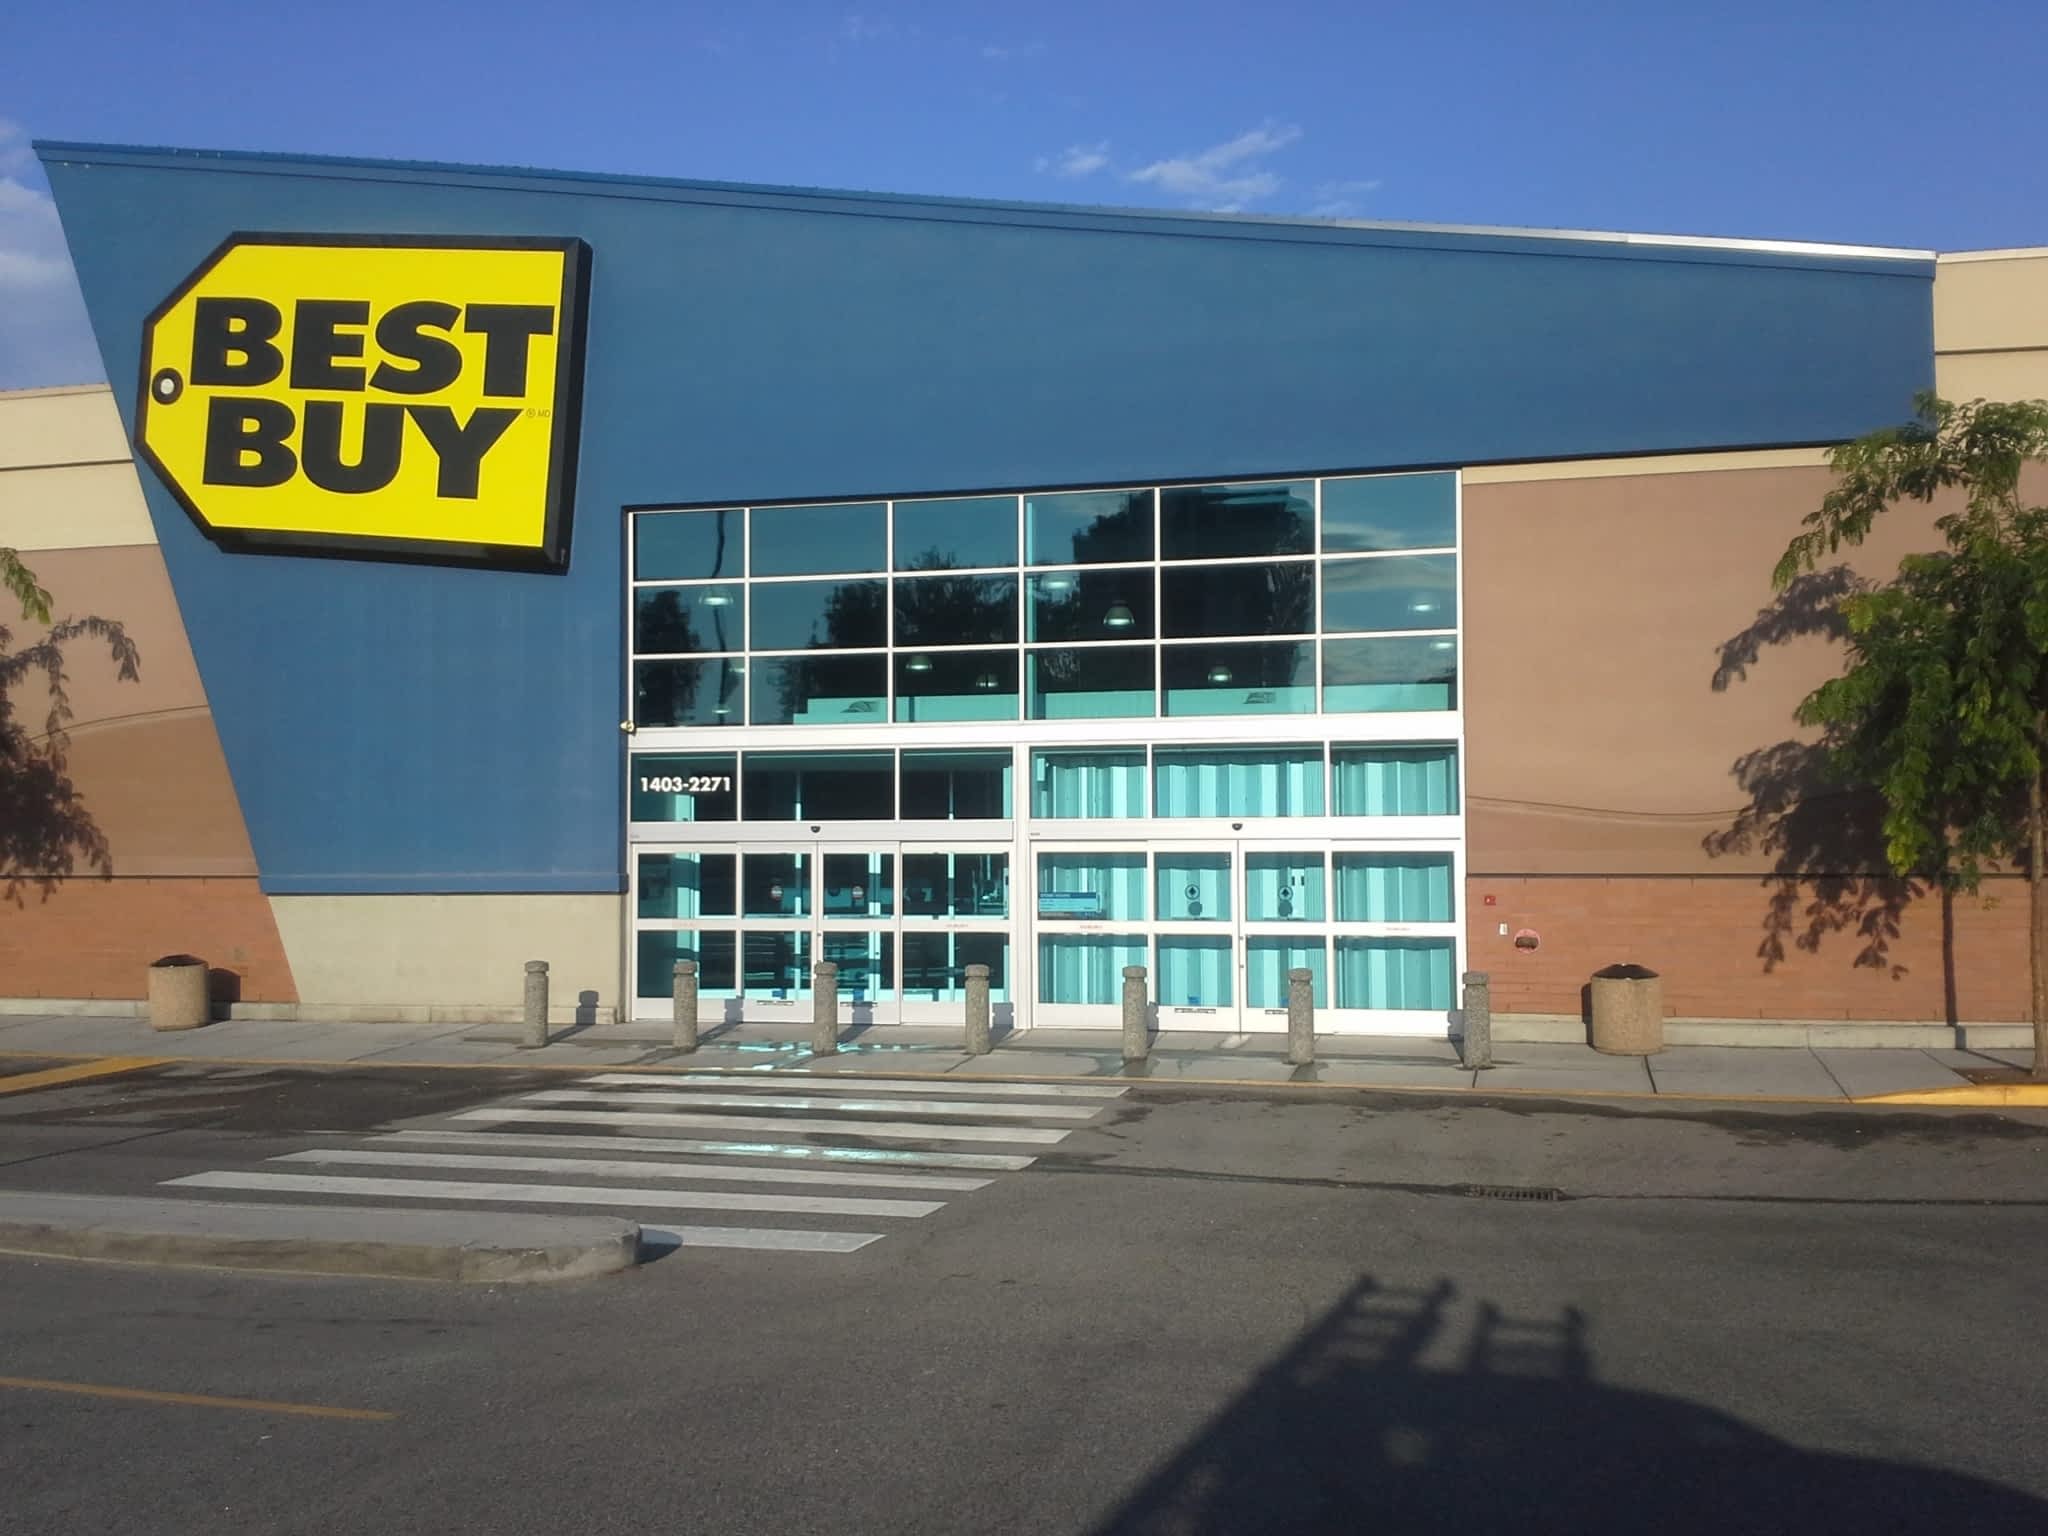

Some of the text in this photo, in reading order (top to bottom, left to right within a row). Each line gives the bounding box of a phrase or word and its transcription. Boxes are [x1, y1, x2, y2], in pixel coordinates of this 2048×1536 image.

[190, 297, 556, 398] BEST
[202, 396, 522, 500] BUY
[640, 776, 731, 792] 1403-2271
